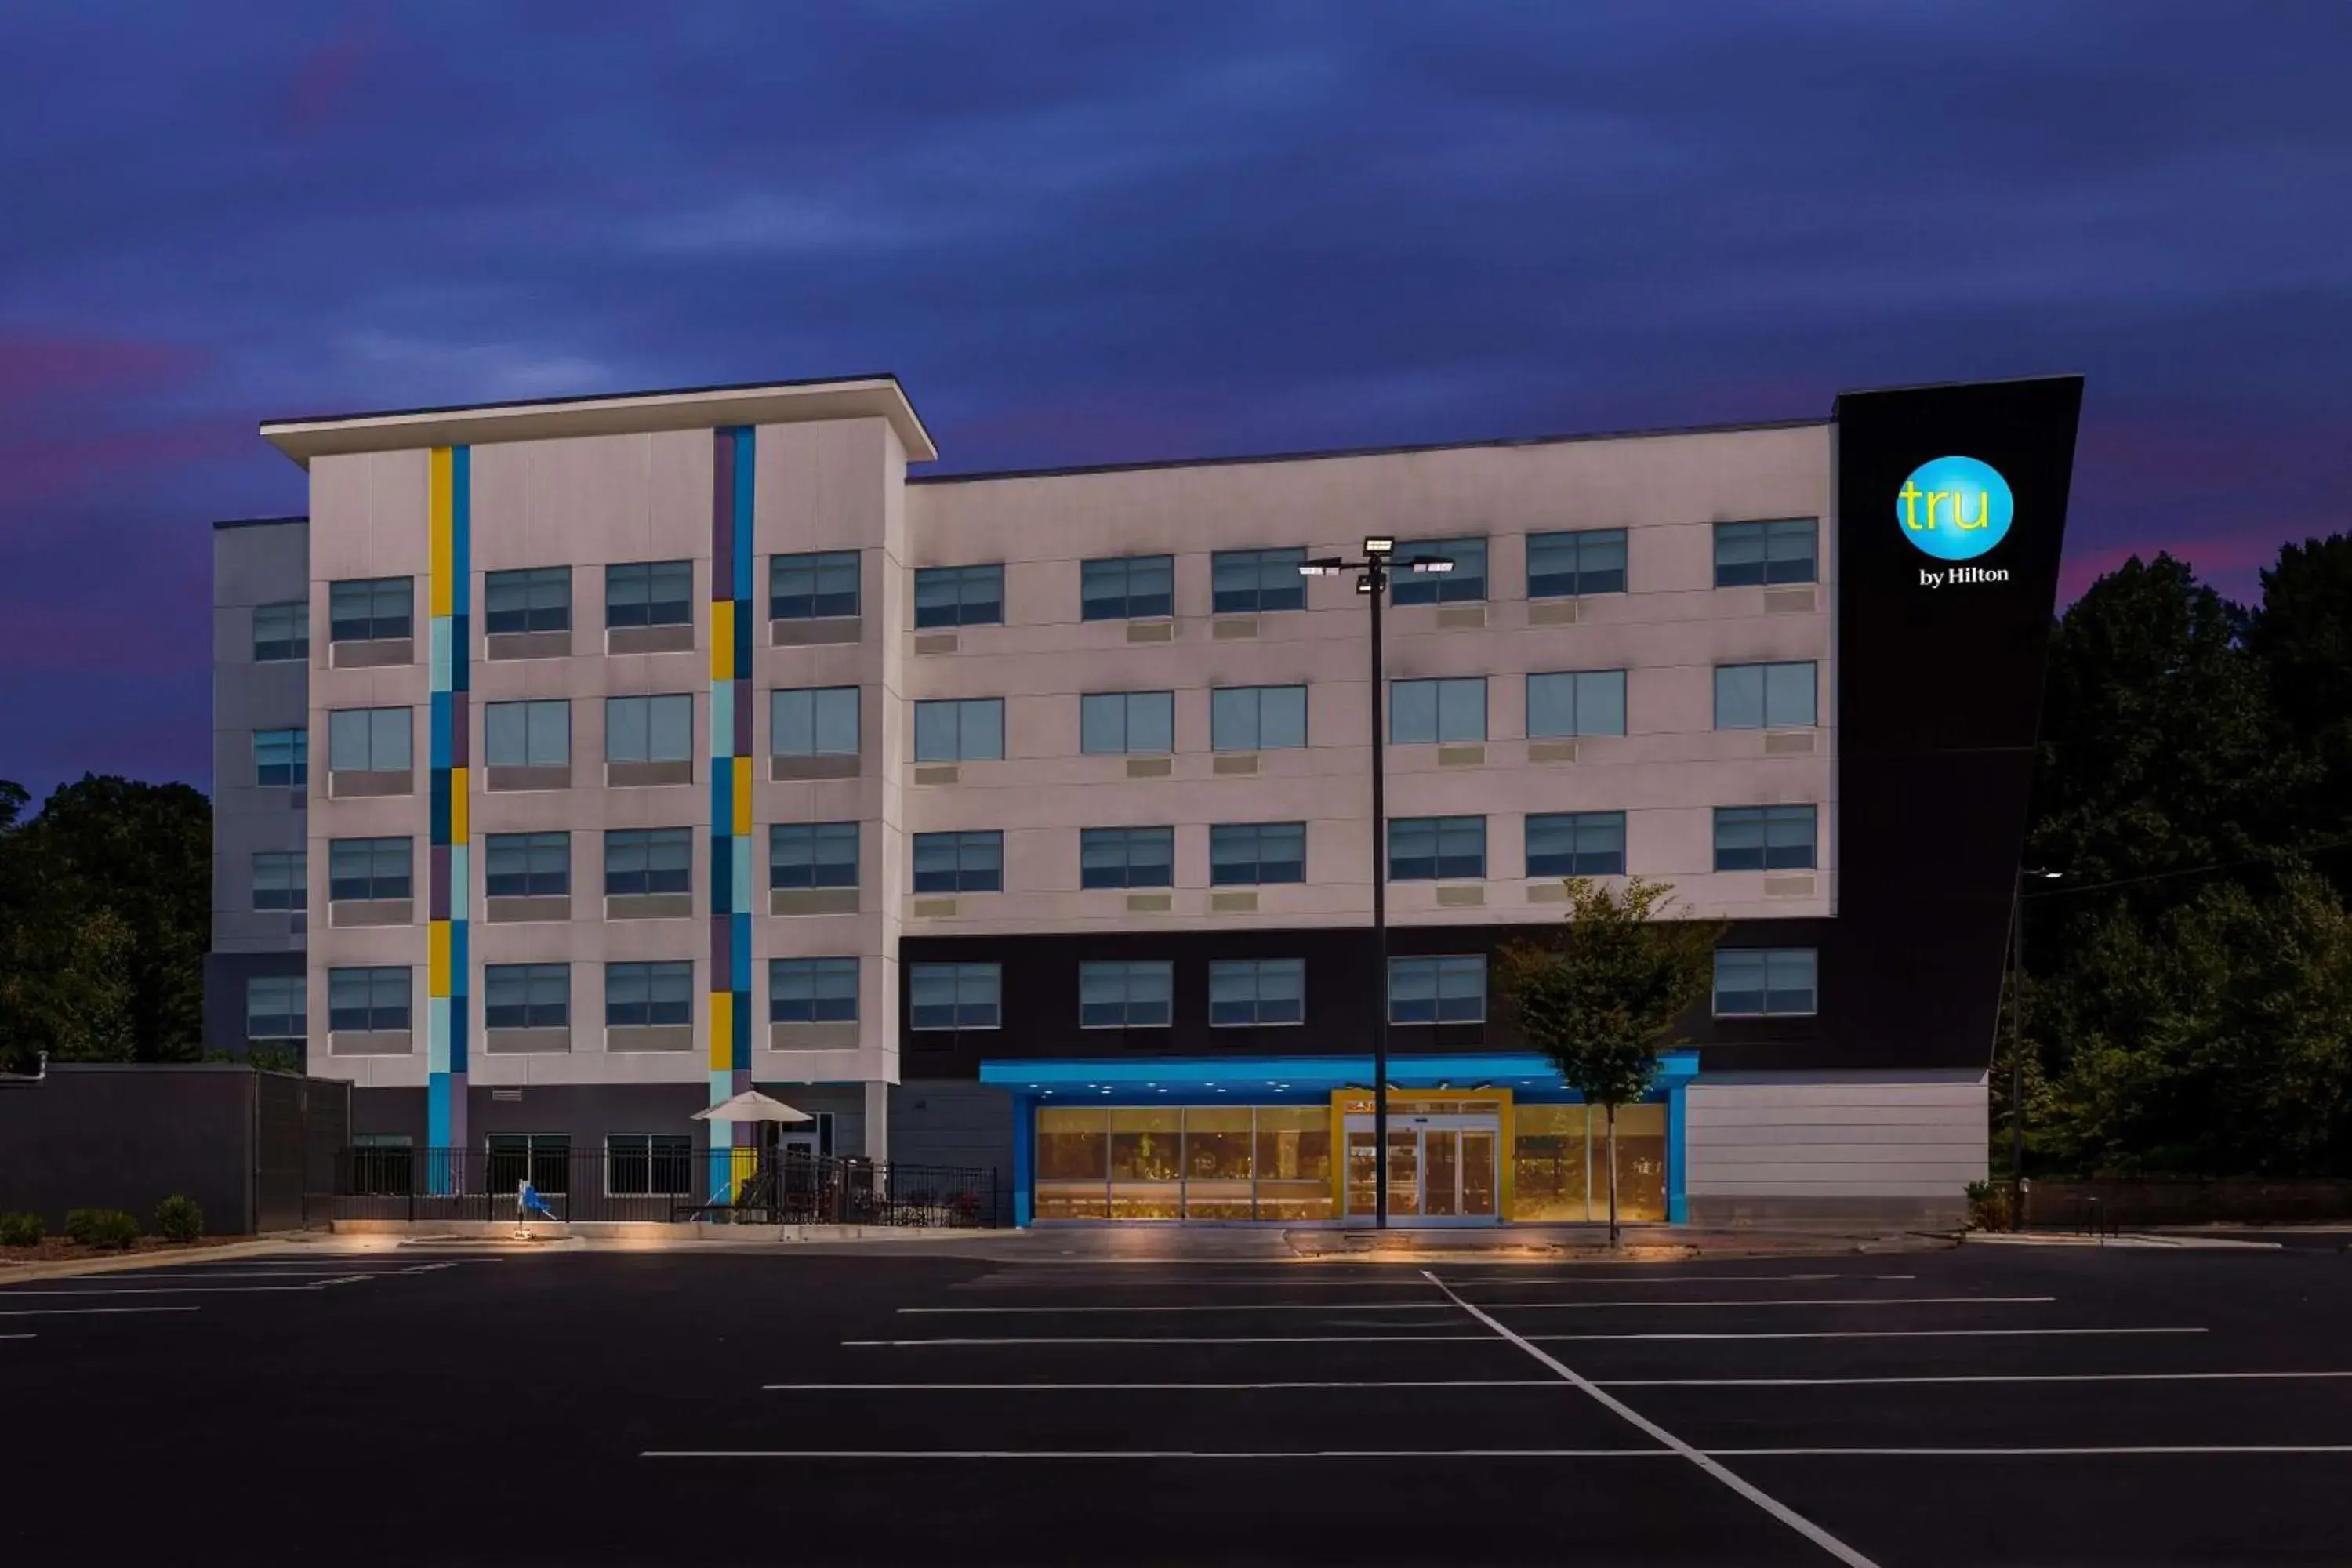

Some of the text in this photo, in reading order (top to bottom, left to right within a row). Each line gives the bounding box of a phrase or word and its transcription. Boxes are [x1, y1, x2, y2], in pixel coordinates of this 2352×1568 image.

[1898, 481, 1988, 530] tru
[1919, 567, 2009, 589] by Hilton
